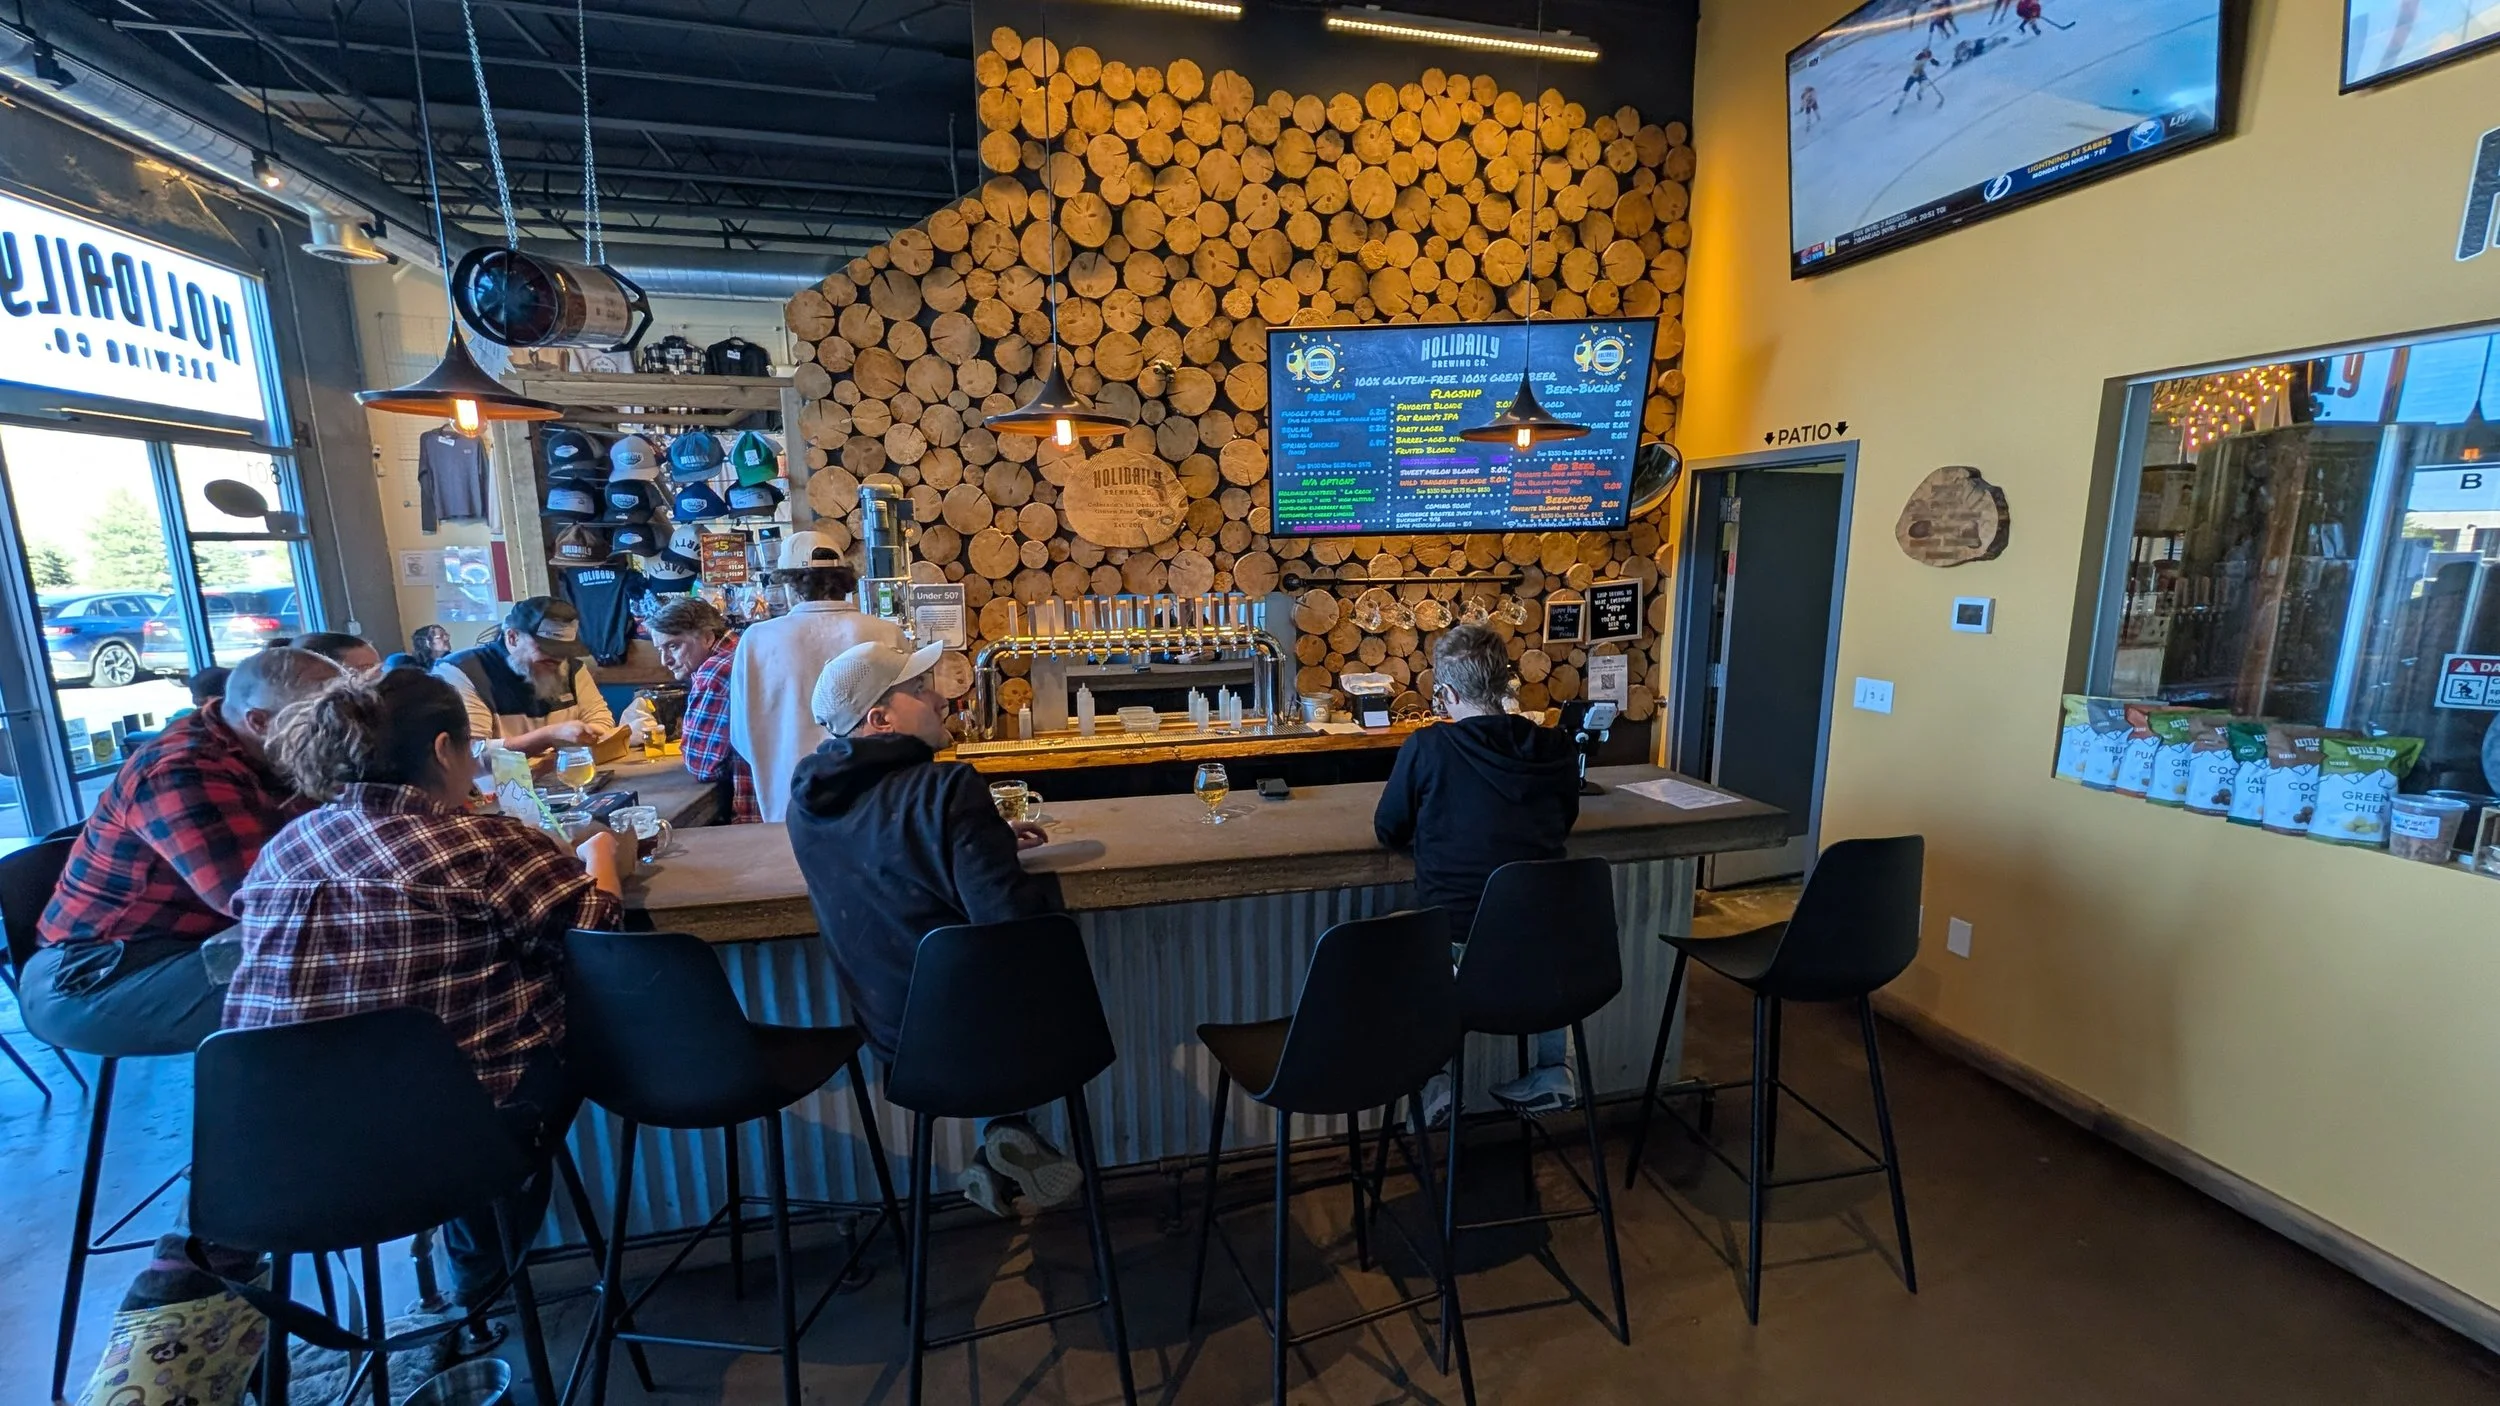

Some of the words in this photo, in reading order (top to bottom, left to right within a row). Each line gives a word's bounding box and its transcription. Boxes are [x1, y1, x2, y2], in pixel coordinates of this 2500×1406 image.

[2027, 153, 2069, 174] LIGHTNING
[2071, 148, 2081, 158] AT
[2082, 137, 2112, 154] SABRES
[2032, 165, 2059, 179] MONDAY
[1420, 333, 1500, 362] HOLIDAILY
[1431, 359, 1470, 368] BREWING
[1474, 358, 1489, 368] CO.
[1354, 377, 1380, 387] 100%
[1462, 374, 1488, 384] 100%
[1490, 372, 1524, 383] GREAT
[1430, 388, 1482, 400] FLAGSHIP
[1545, 384, 1622, 395] BEER-BUCHAS
[1306, 392, 1356, 402] PREMIUM
[1396, 403, 1432, 411] FAVORITE
[1433, 402, 1463, 410] BLONDE
[1396, 414, 1411, 422] FAT
[1412, 413, 1440, 422] RANDY'S
[1442, 412, 1459, 420] IPA
[1396, 425, 1419, 433] DARTY
[1420, 424, 1444, 432] LAGER
[1778, 422, 1832, 446] PATIO
[1396, 436, 1446, 444] BARREL-AGED
[1281, 442, 1307, 450] SPRING
[1396, 446, 1424, 454] FRUITED
[1551, 463, 1569, 471] RED
[1572, 462, 1596, 470] BEER
[1425, 468, 1452, 476] MELON
[1302, 479, 1318, 487] N/A
[1320, 478, 1356, 486] OPTIONS
[2460, 473, 2482, 490] B
[1545, 496, 1593, 504] BEERMOSA
[714, 540, 730, 550] $5
[916, 592, 942, 600] Under
[944, 592, 959, 600] 50?
[2347, 746, 2375, 756] KETTLE
[2376, 746, 2397, 758] HEAD
[2342, 790, 2390, 802] GREEN
[2344, 802, 2384, 814] CHILE
